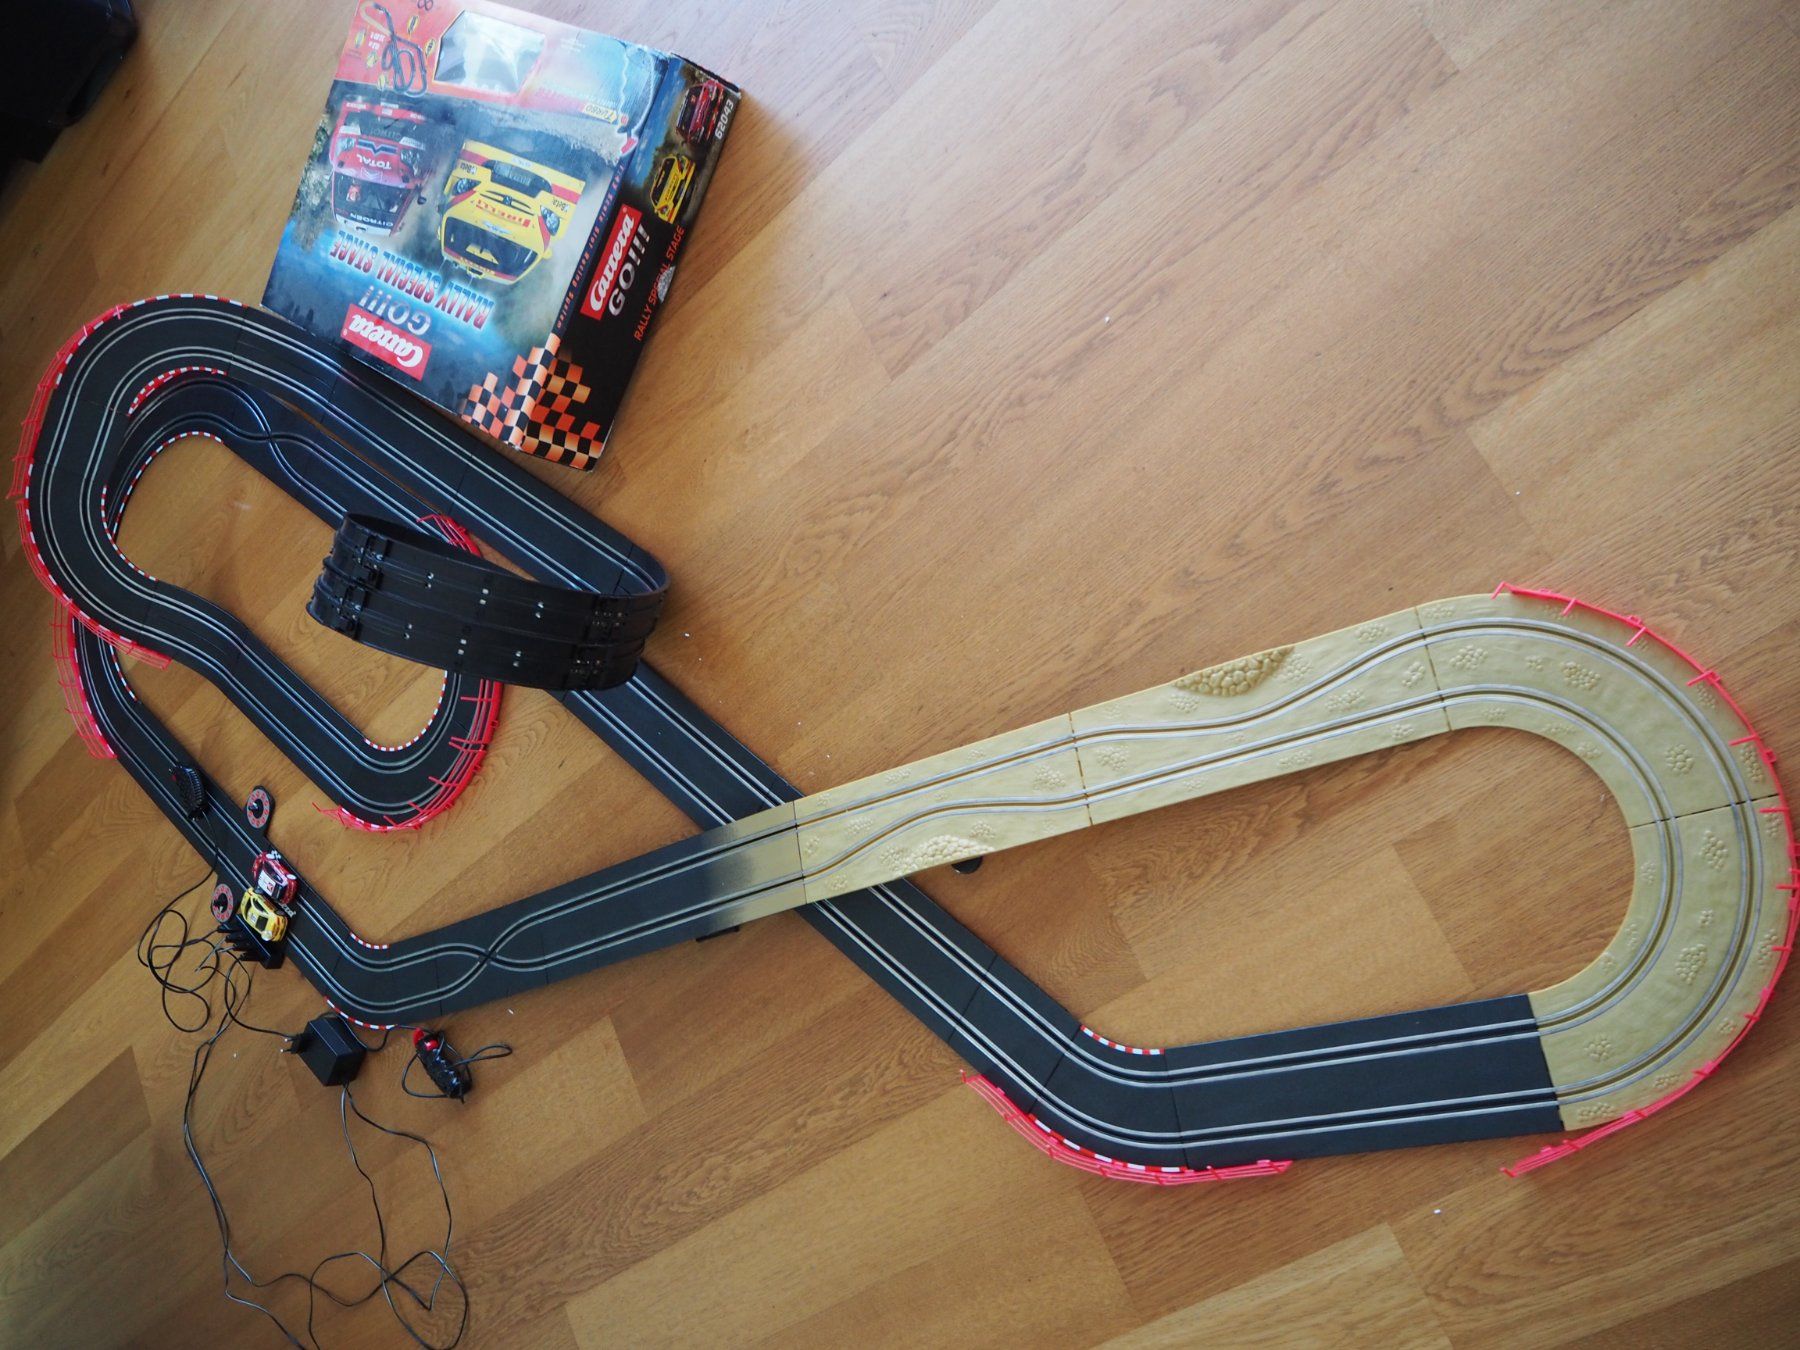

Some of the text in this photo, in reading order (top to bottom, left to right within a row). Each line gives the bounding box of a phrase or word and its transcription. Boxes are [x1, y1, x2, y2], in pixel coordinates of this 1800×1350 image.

[714, 99, 734, 139] 62043
[356, 153, 391, 170] TOTAL
[330, 230, 495, 329] RALLY SPECIAL STAGE
[590, 214, 634, 311] Carrera
[608, 223, 650, 316] GO!!!
[634, 304, 652, 341] RALLY
[666, 225, 685, 261] STAGE
[349, 314, 423, 367] Carrera
[358, 285, 431, 335] GO!!!
